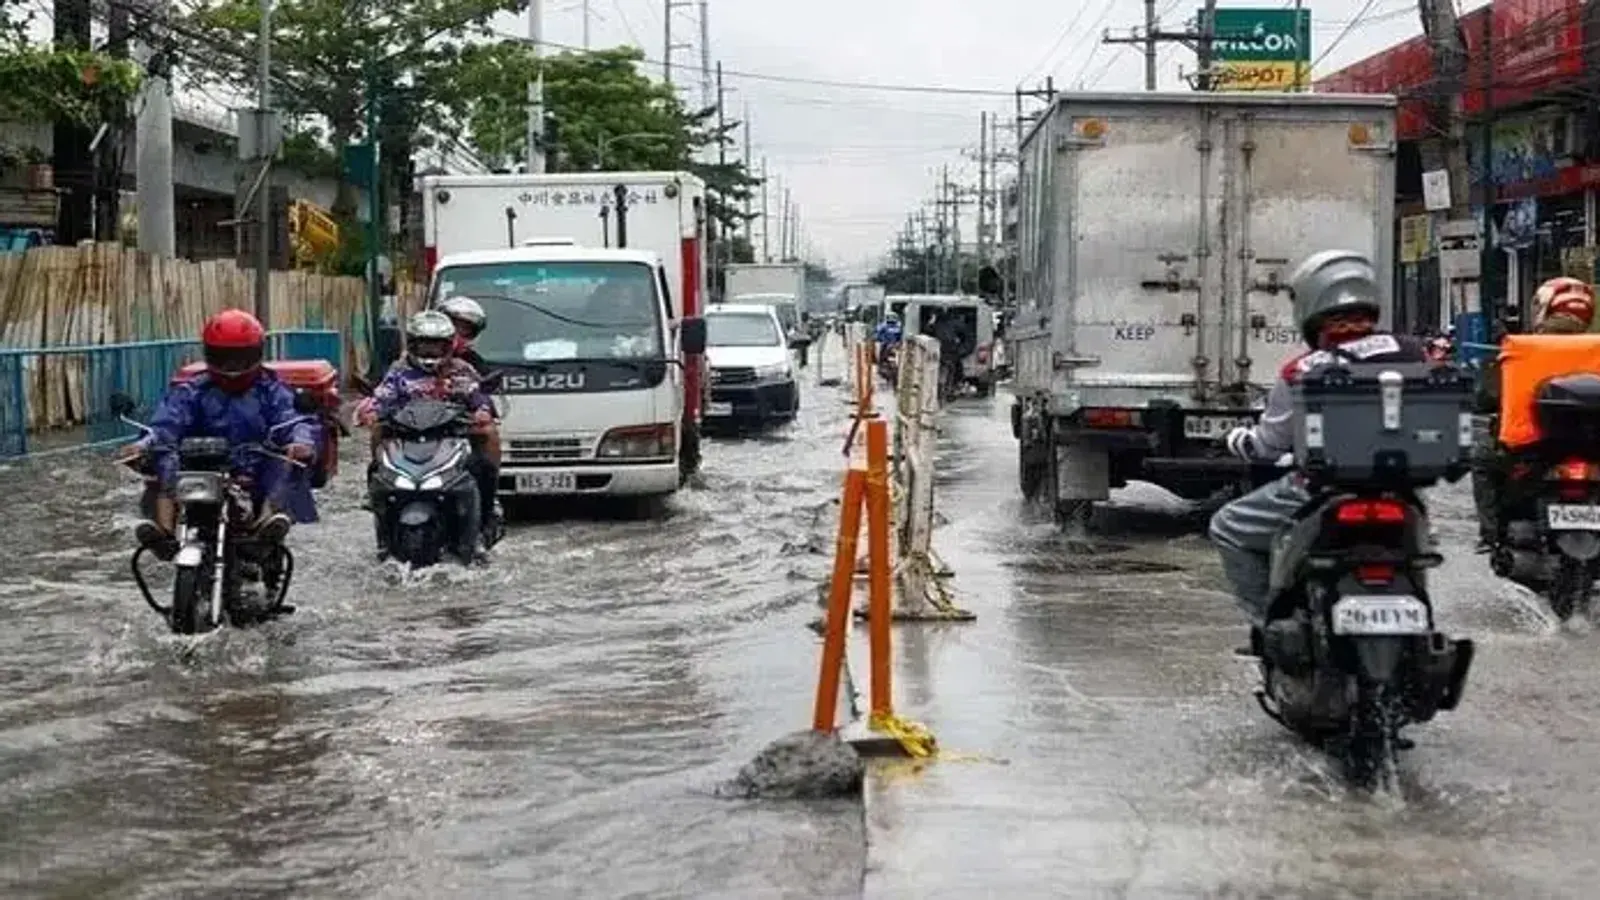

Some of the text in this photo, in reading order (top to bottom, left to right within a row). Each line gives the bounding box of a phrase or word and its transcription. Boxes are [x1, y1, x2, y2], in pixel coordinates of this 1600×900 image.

[1115, 326, 1156, 341] KEEP
[1264, 329, 1304, 344] DIST
[502, 372, 586, 390] ISUZU
